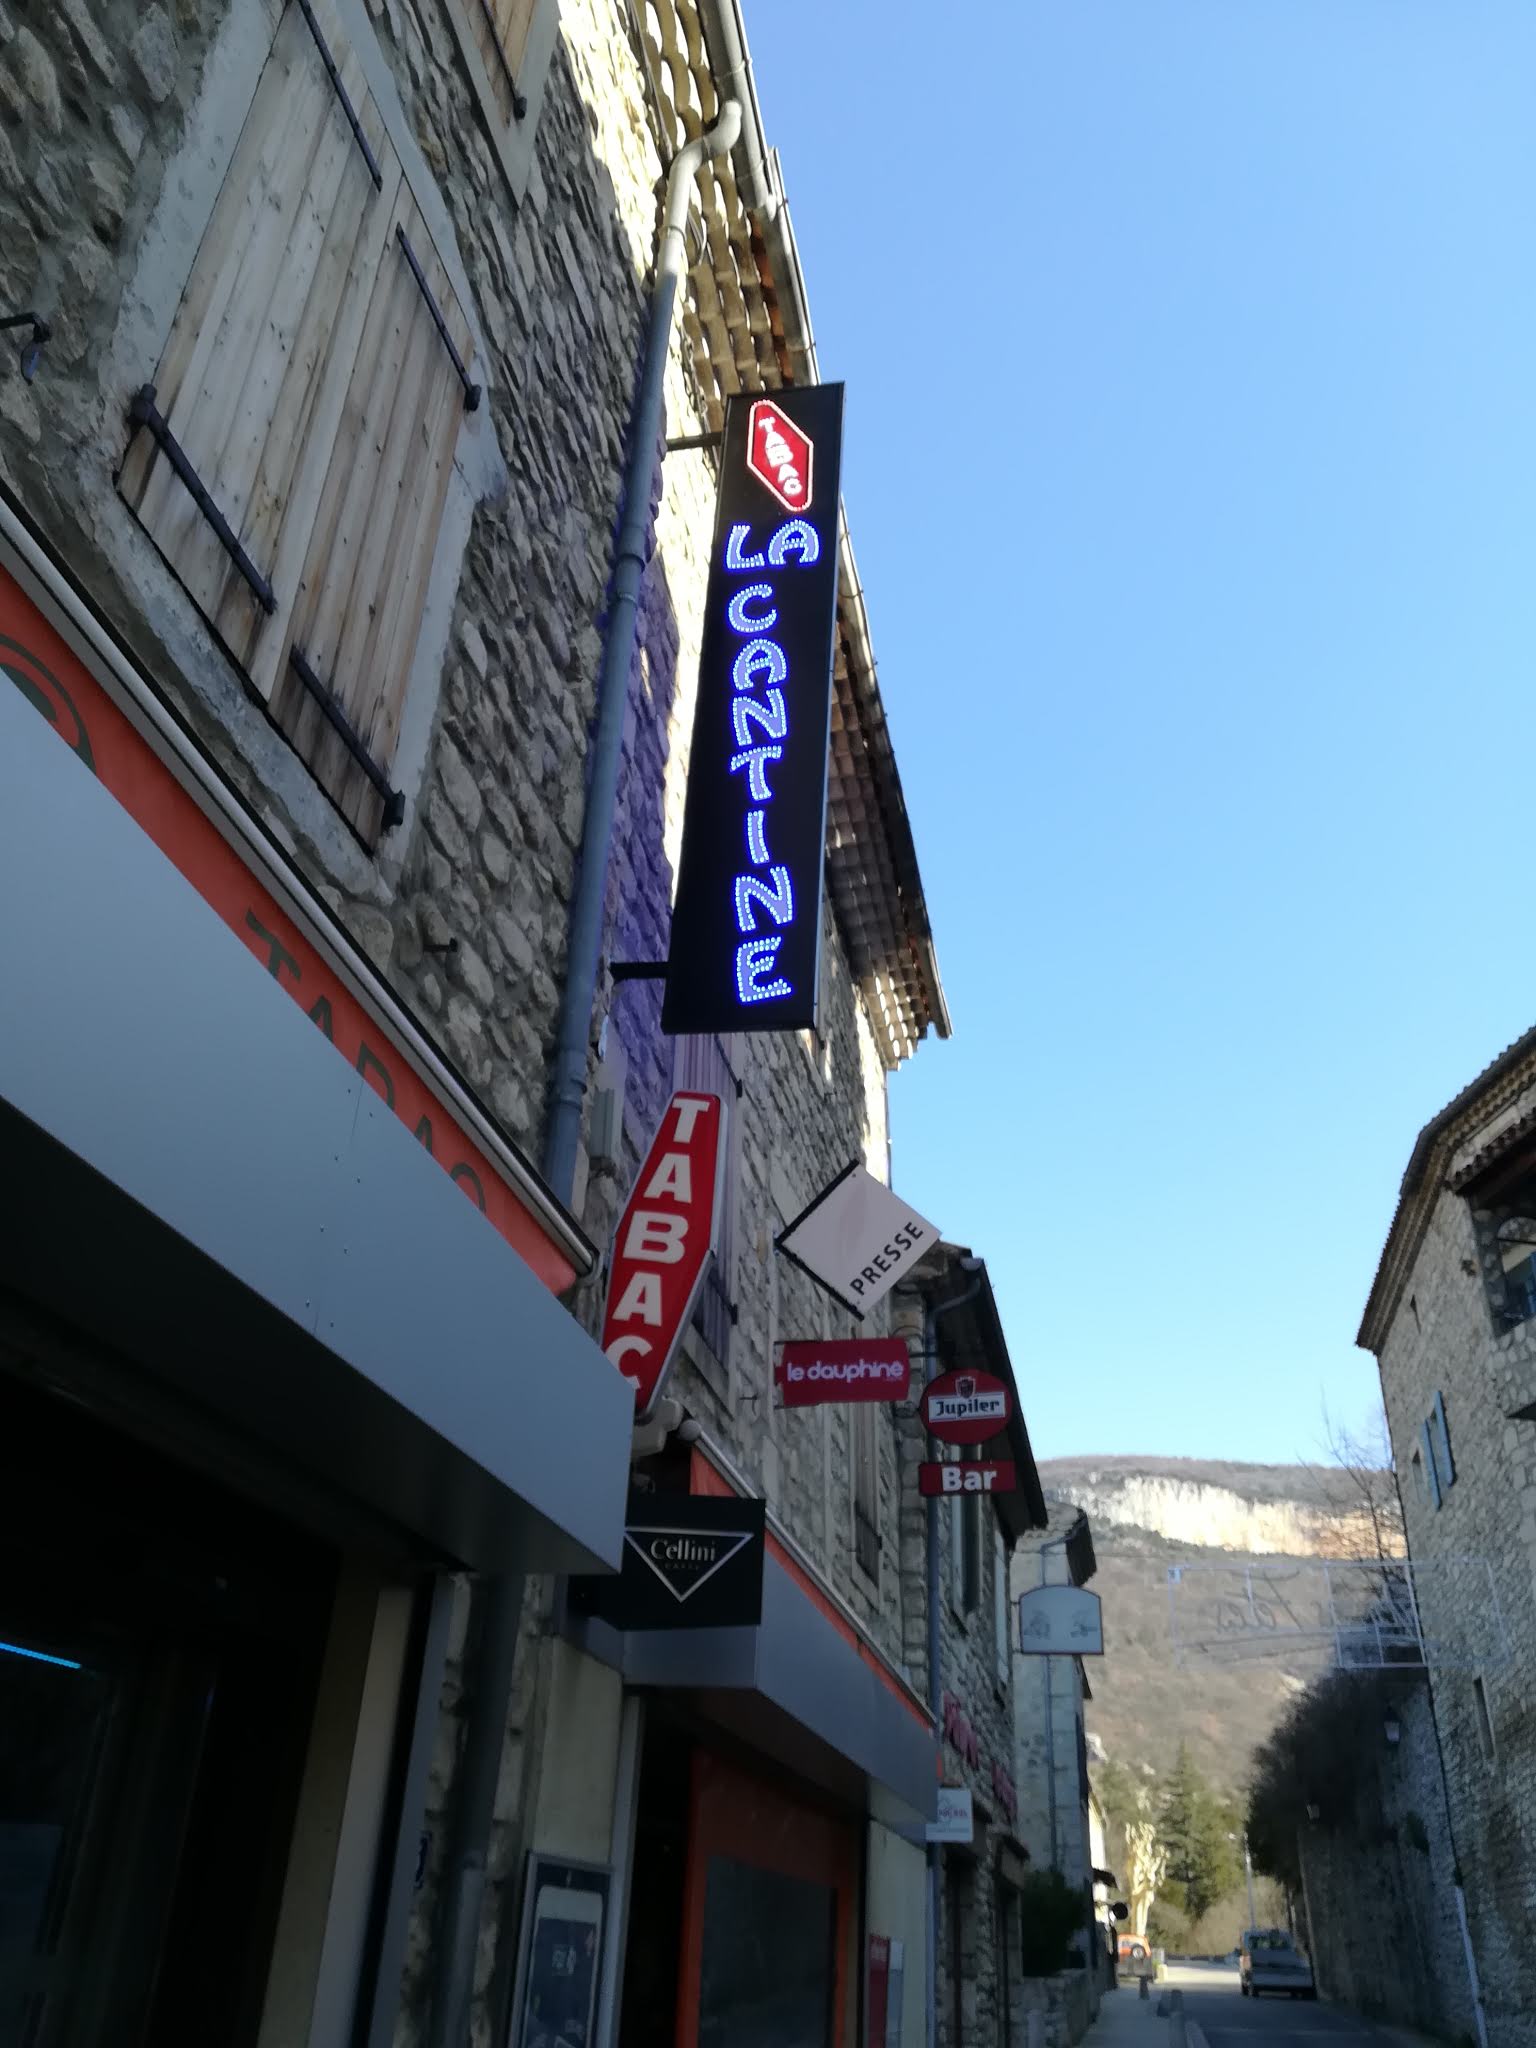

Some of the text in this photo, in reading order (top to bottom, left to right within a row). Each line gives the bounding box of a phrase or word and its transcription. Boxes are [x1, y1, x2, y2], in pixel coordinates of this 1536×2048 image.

[758, 416, 803, 497] TABAC
[726, 519, 820, 569] LA
[728, 584, 793, 1003] CANTINE
[606, 1098, 709, 1390] TABAC
[850, 1221, 923, 1296] PRESSE
[787, 1362, 804, 1382] le
[936, 1398, 1000, 1417] Jupiler
[942, 1465, 997, 1491] Bar
[650, 1538, 716, 1561] Cellini
